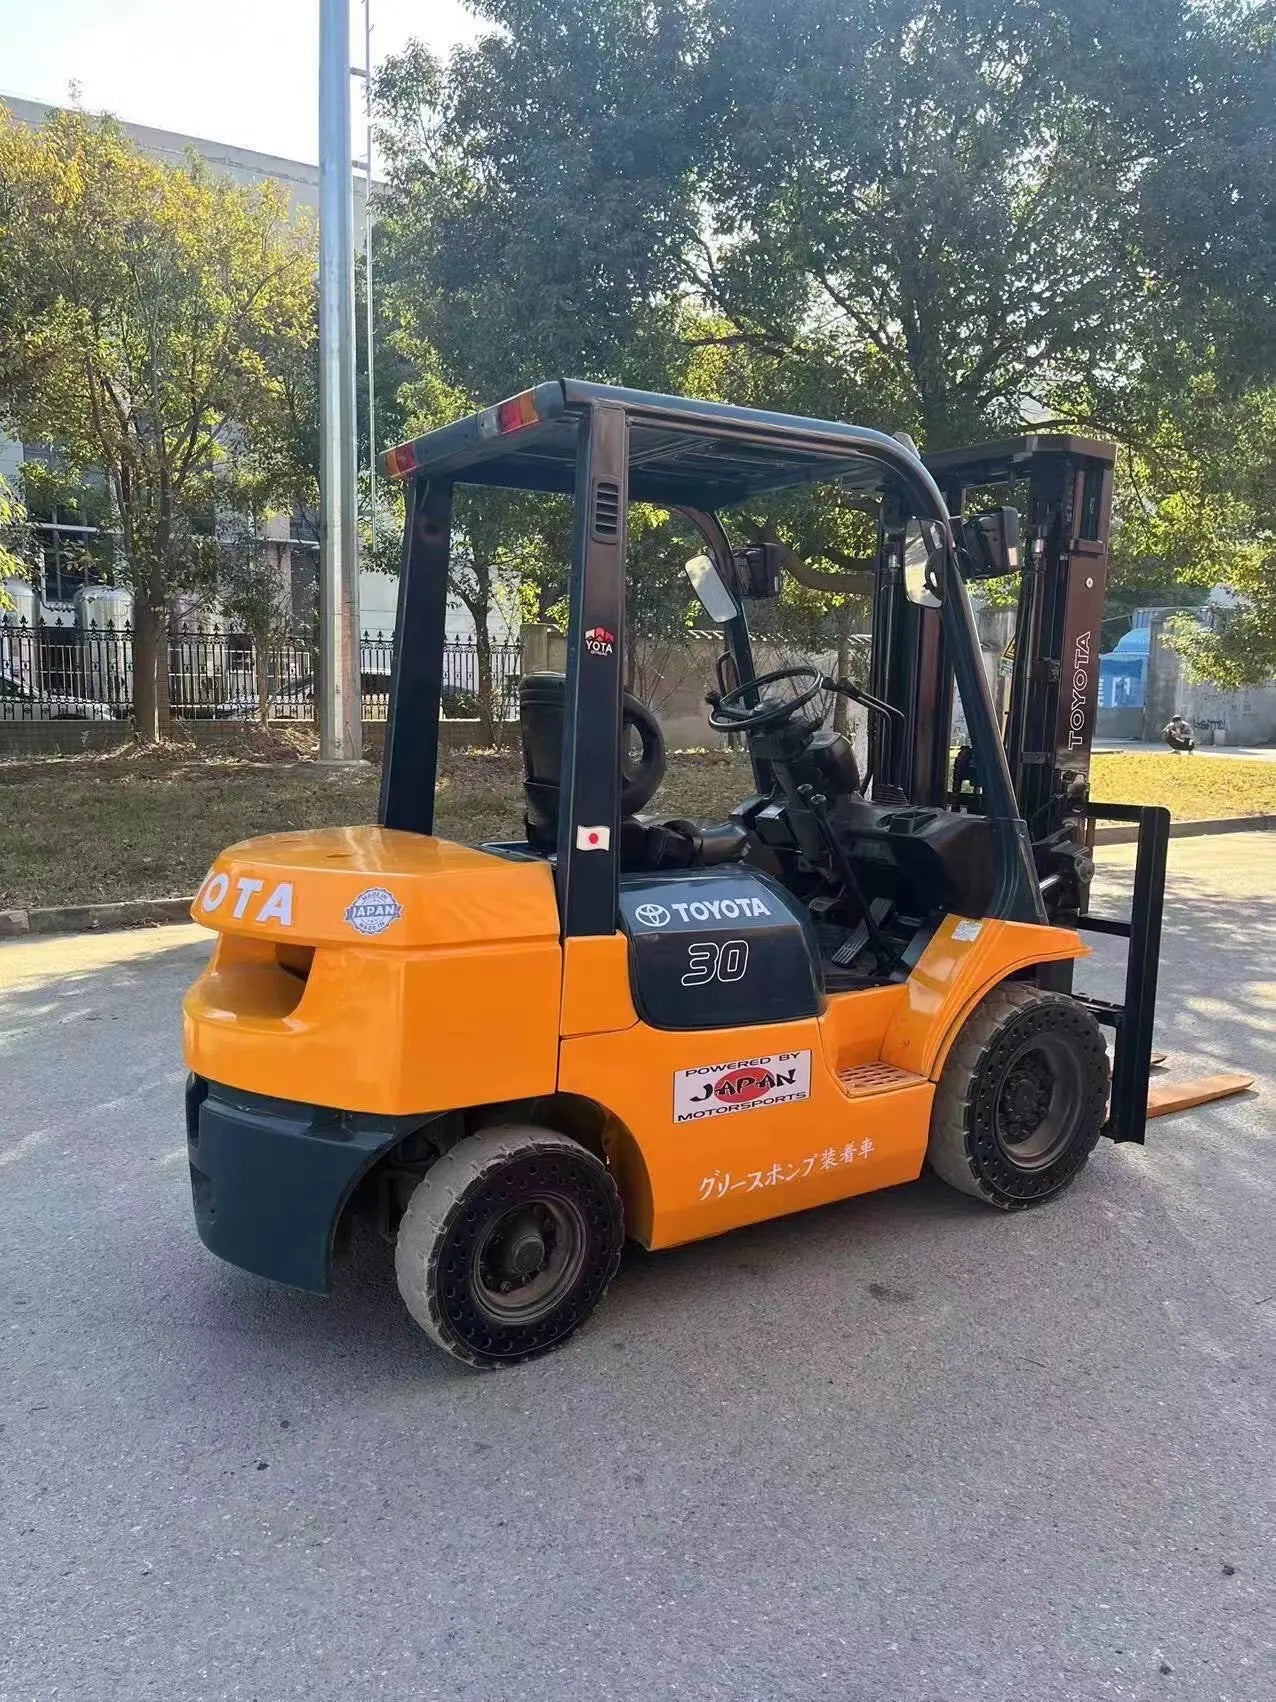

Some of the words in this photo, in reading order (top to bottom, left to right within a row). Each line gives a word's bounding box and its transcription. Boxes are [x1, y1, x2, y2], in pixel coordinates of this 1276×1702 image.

[585, 639, 613, 654] YOTA
[1068, 631, 1091, 751] TOYOTA
[199, 870, 294, 927] OTA
[352, 904, 395, 917] JAPAN
[671, 897, 771, 922] TOYOTA
[681, 940, 749, 986] 30
[685, 1057, 771, 1078] POWERED
[778, 1052, 801, 1062] BY
[689, 1069, 797, 1103] JAPAN
[677, 1091, 807, 1122] MOTORSPORTS
